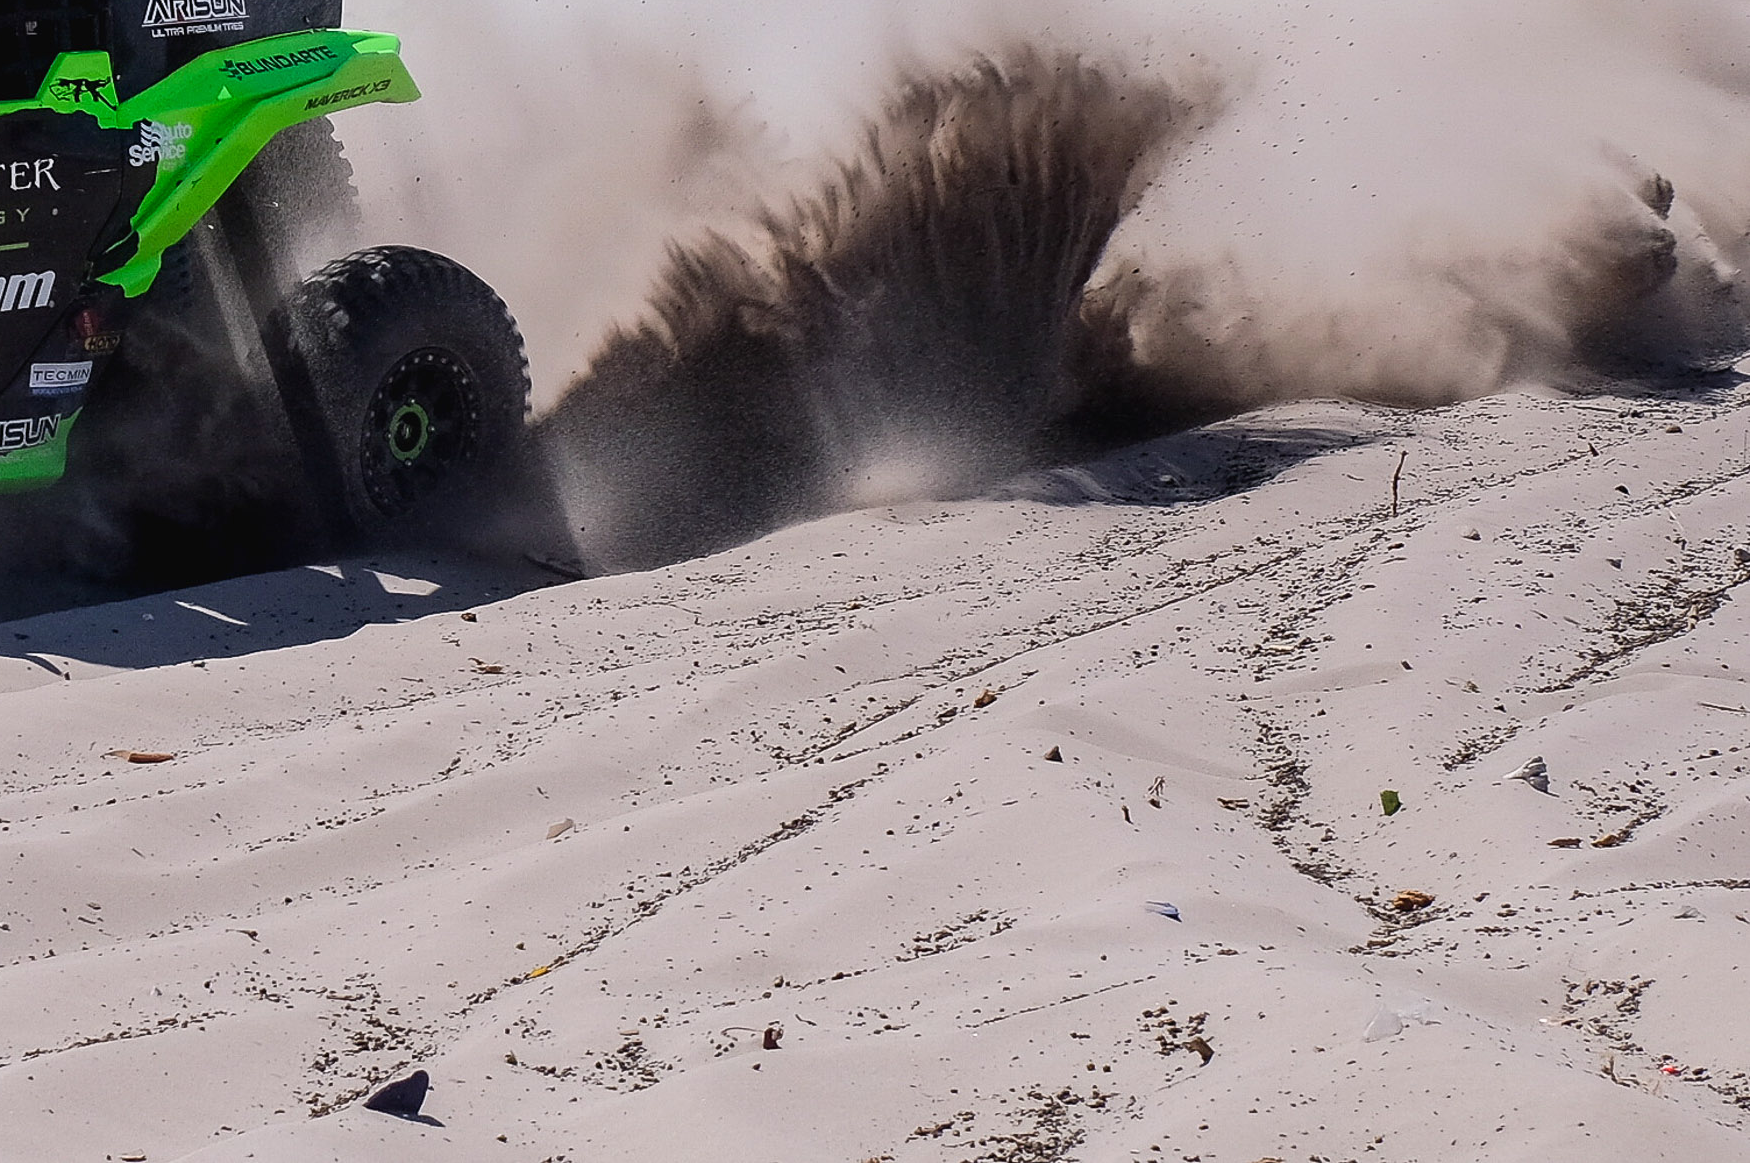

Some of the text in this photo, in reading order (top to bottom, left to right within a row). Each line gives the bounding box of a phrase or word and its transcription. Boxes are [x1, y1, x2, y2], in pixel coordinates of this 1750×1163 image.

[234, 44, 338, 76] BLINDARTE
[304, 85, 368, 111] MAVERICK
[33, 368, 90, 381] TECMIN
